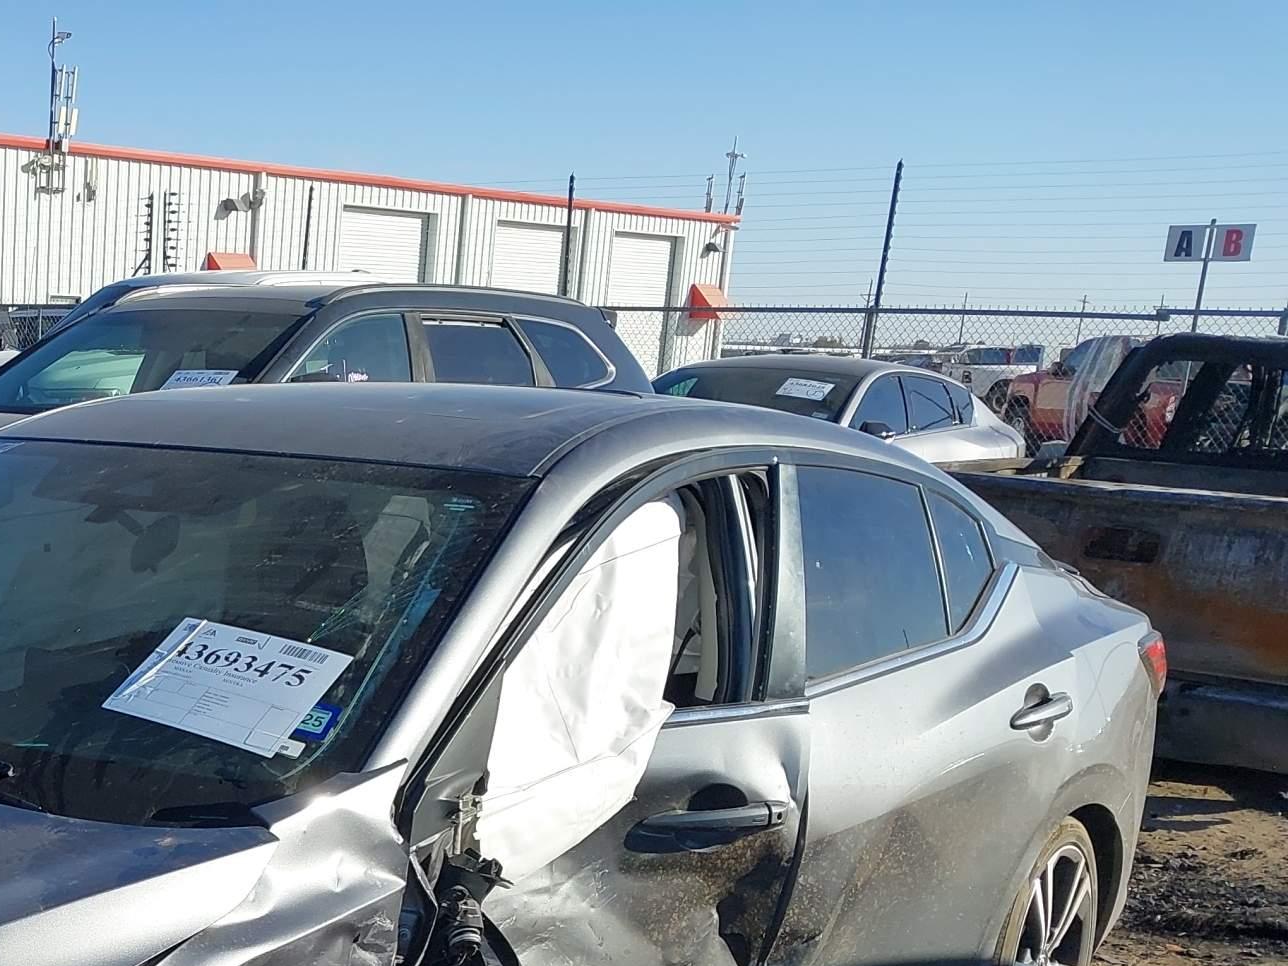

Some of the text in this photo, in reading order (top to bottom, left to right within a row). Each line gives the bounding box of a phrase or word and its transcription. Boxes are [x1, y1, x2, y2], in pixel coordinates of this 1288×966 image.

[1174, 230, 1193, 257] A
[1222, 229, 1244, 257] B
[193, 662, 223, 676] Casualty
[223, 671, 258, 685] Insurance
[301, 713, 325, 728] 25
